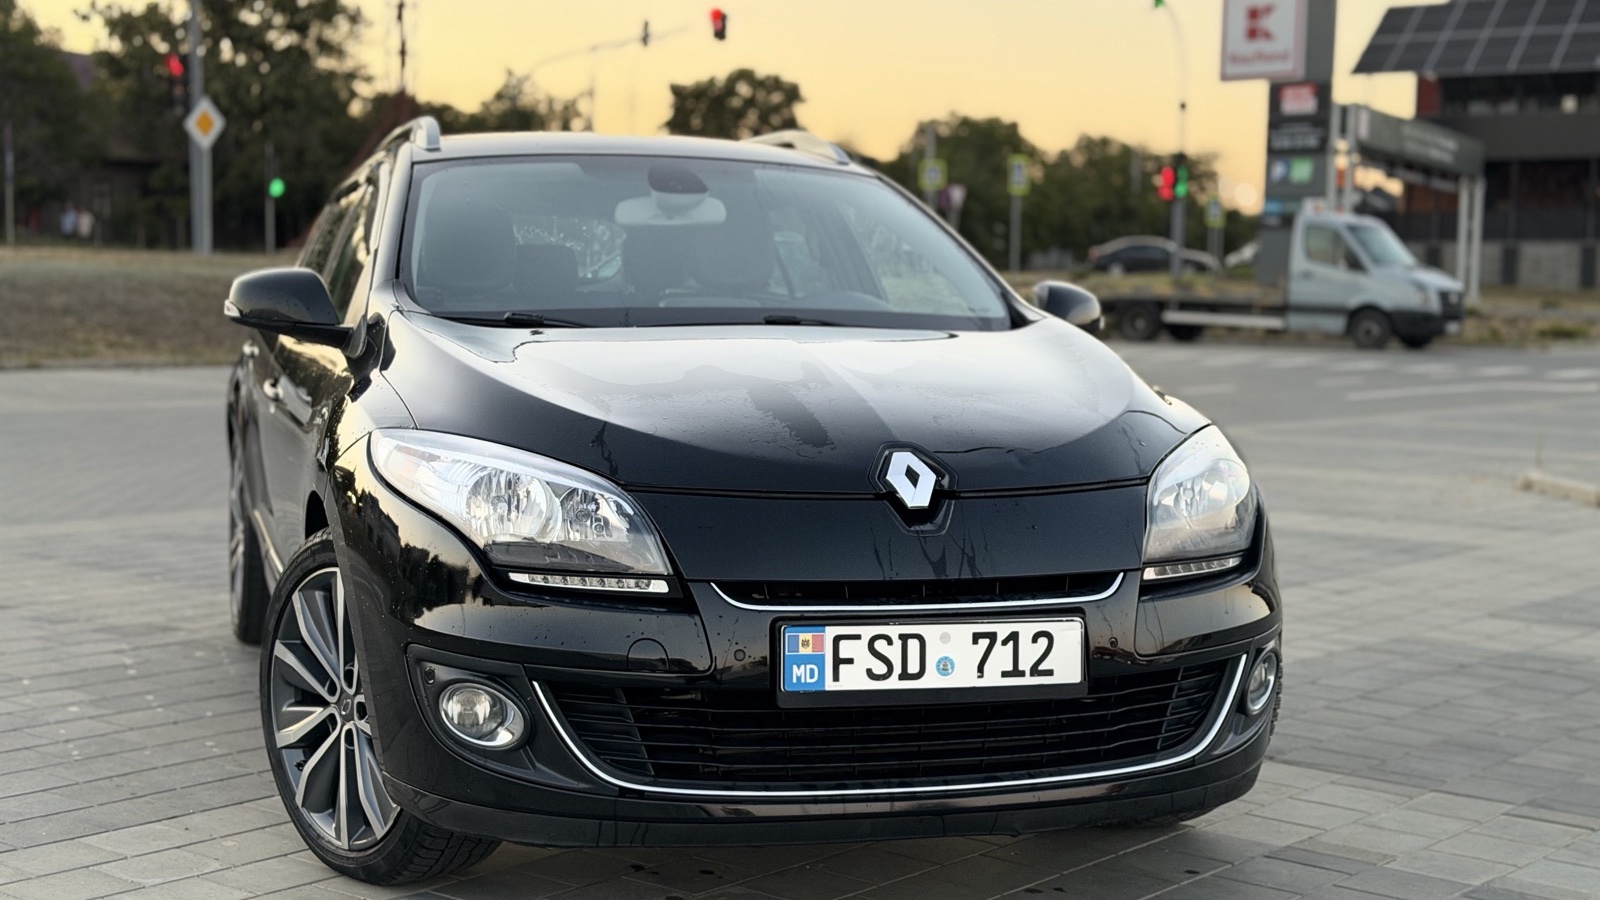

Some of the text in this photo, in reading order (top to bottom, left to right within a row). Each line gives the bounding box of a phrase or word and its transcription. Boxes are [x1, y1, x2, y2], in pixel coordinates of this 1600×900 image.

[792, 664, 819, 683] MD
[832, 633, 927, 682] FSD
[971, 630, 1055, 677] 712
